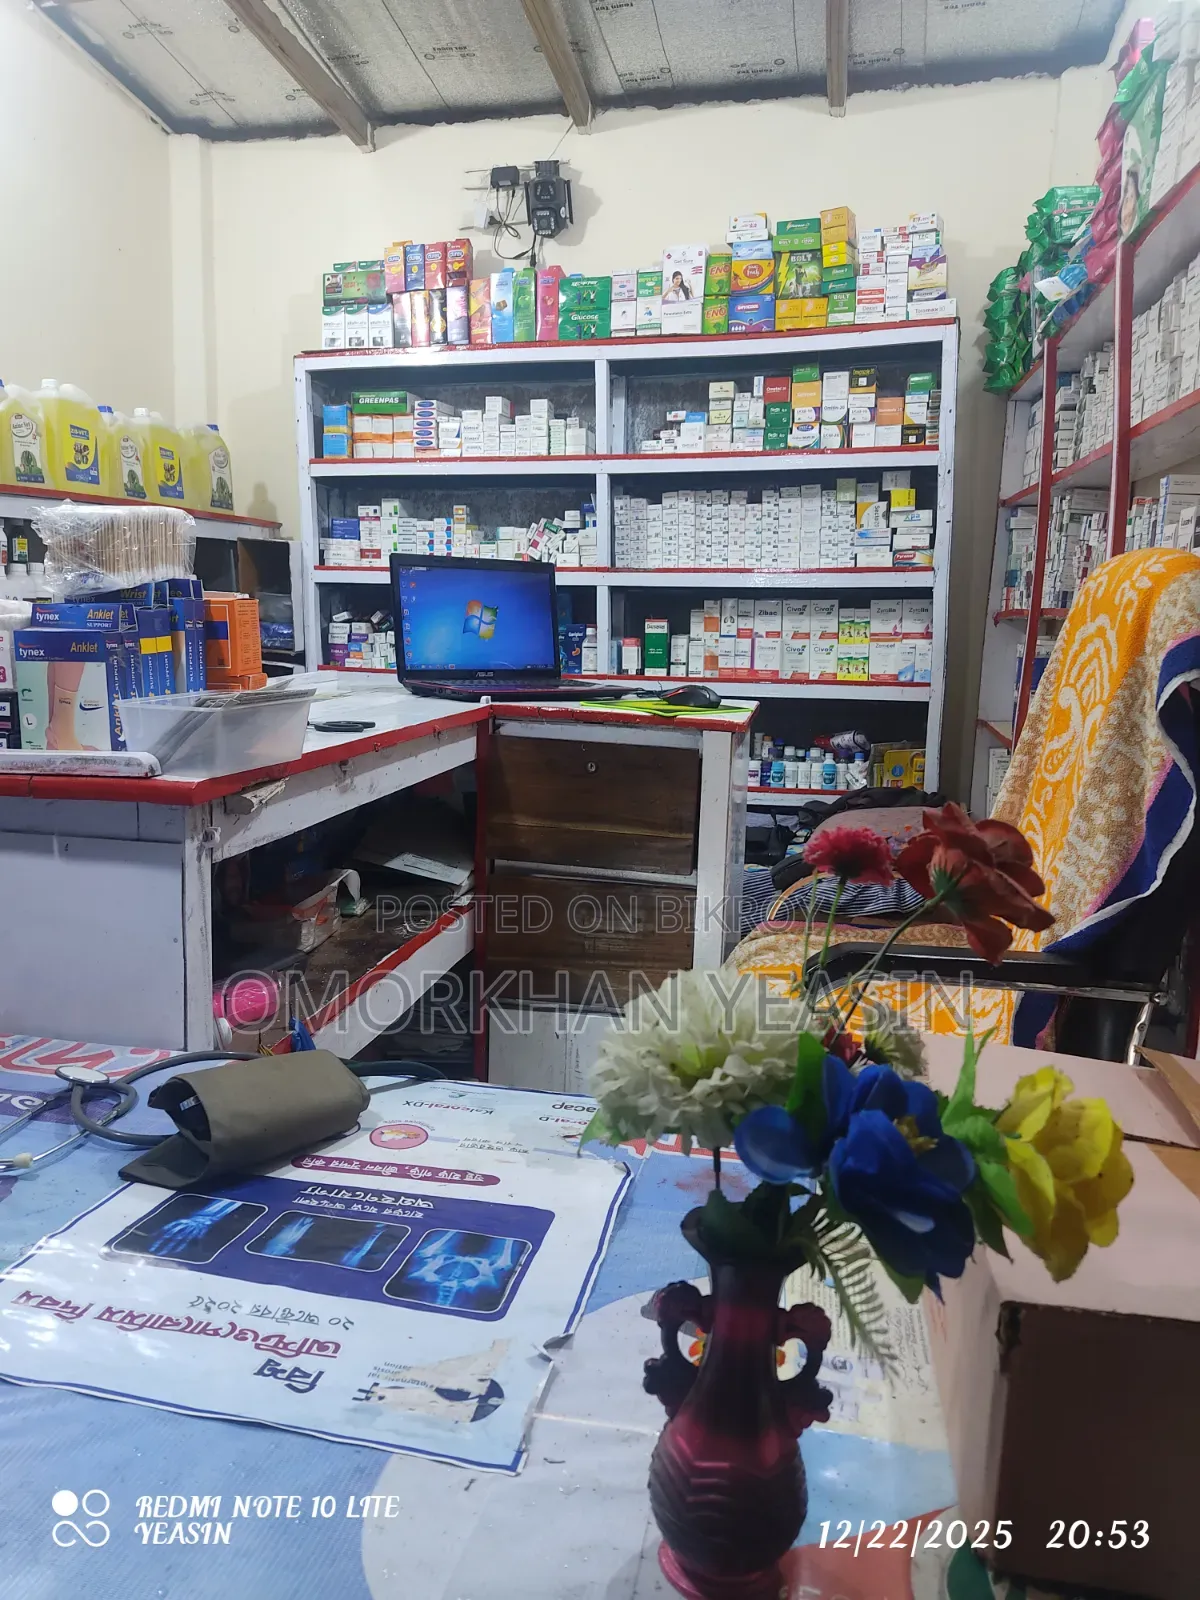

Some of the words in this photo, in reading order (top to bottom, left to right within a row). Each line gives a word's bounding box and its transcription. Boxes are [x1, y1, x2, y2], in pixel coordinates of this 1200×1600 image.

[709, 264, 731, 275] ENO
[706, 306, 726, 318] ENO
[120, 588, 147, 600] Wrist
[36, 611, 60, 622] tynex
[86, 608, 115, 620] Anklet
[18, 647, 45, 659] tynex
[70, 641, 98, 653] Anklet
